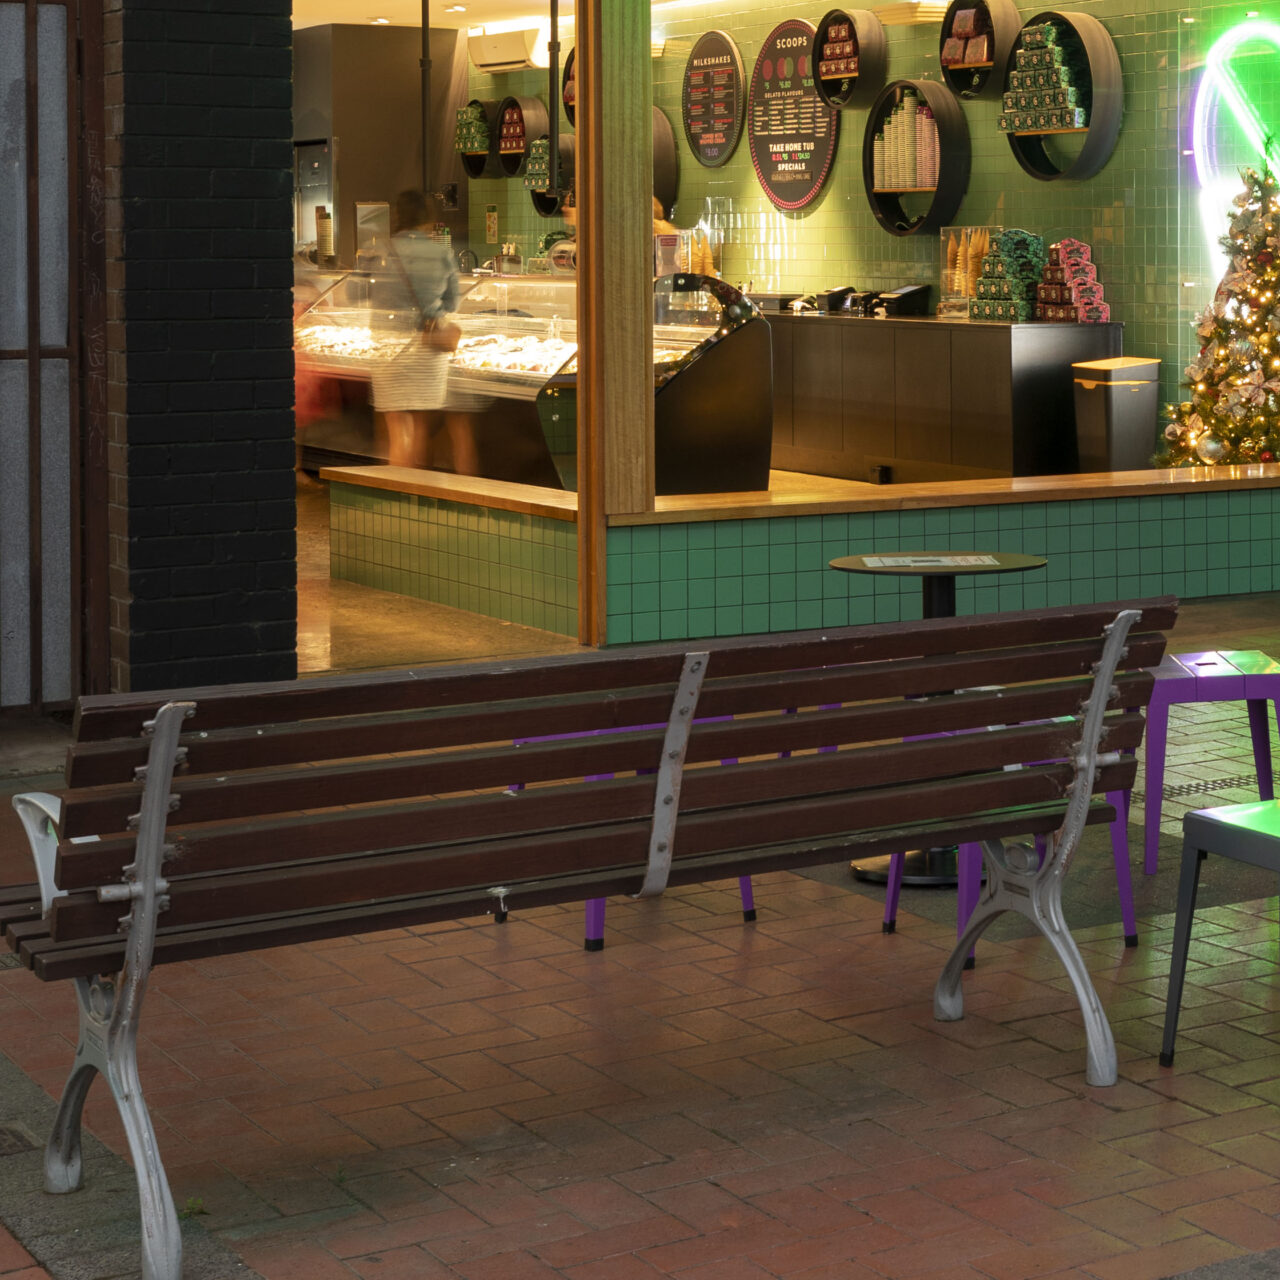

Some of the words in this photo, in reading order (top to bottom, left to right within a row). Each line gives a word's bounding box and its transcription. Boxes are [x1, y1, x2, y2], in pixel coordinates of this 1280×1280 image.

[776, 36, 808, 49] SCOOPS
[693, 55, 731, 67] MILKSHAKES
[769, 143, 785, 152] TAKE
[785, 142, 802, 152] HOME
[803, 142, 815, 151] TUB
[777, 162, 806, 171] SPECIALS
